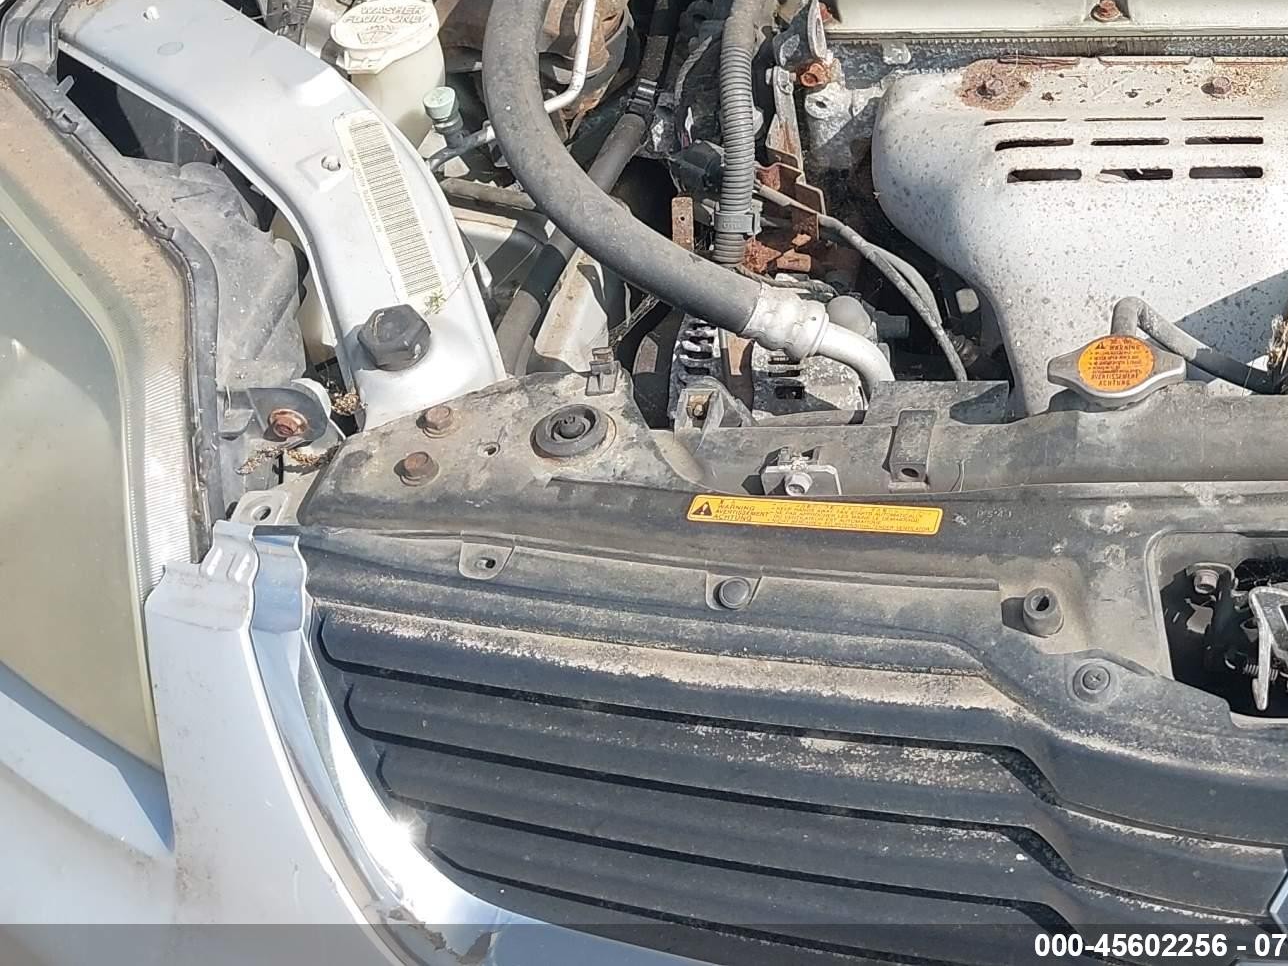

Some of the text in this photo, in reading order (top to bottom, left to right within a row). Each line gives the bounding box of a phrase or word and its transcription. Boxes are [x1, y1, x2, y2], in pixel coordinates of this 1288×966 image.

[361, 5, 425, 15] WASHER
[343, 14, 430, 24] FLUID ONLY
